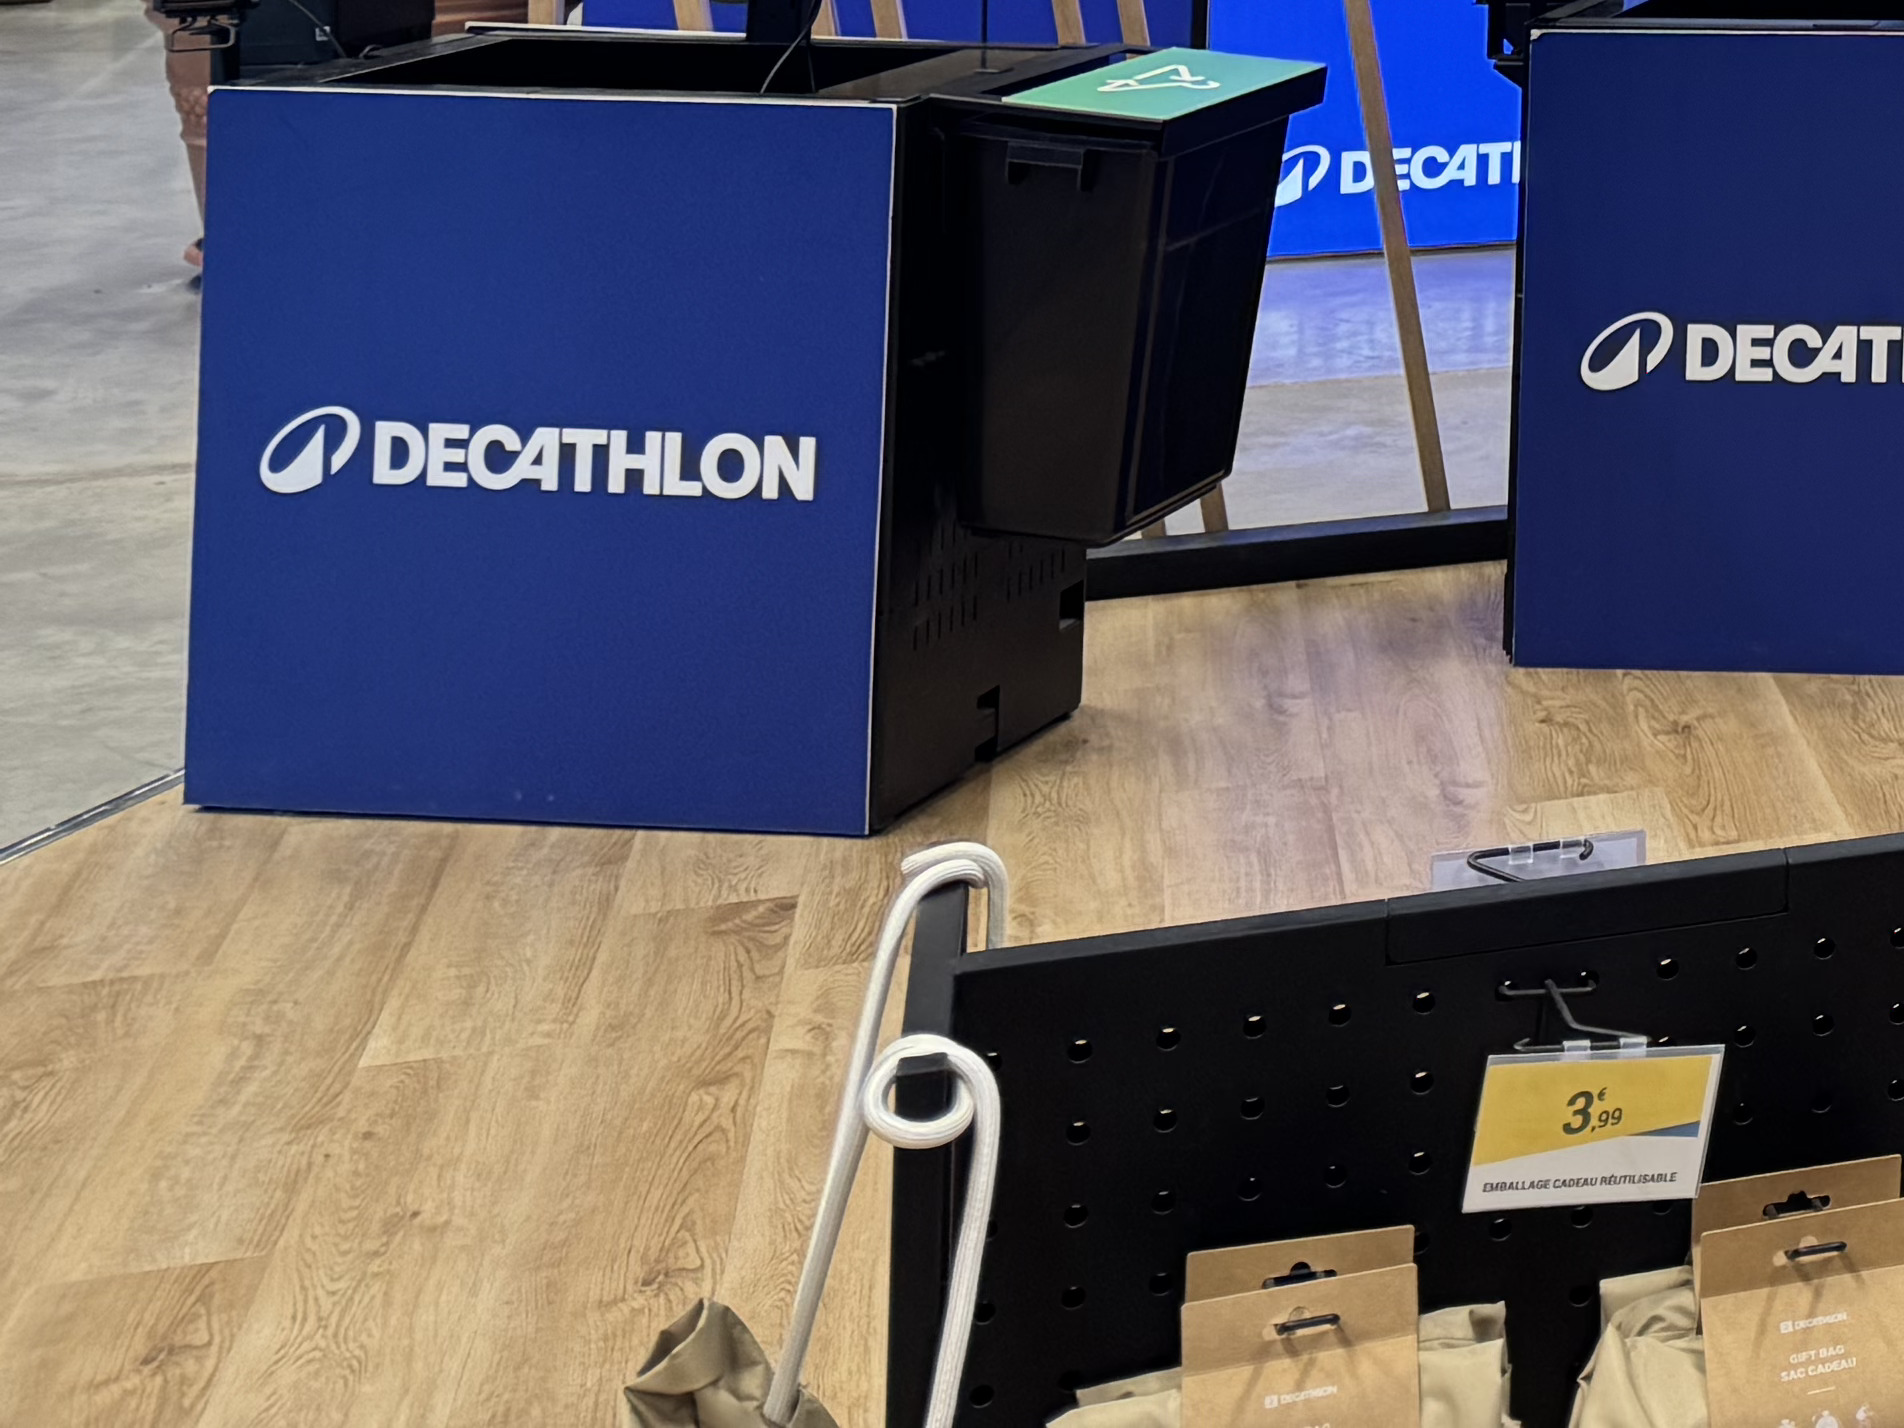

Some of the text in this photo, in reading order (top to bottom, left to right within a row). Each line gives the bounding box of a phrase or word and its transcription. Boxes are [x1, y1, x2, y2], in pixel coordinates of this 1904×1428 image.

[372, 420, 817, 501] DECATHLON
[1481, 1170, 1679, 1194] EMBALLAGE CADEAU RÉUTILISABLE
[1789, 1344, 1846, 1364] GIFT BAG
[1779, 1357, 1857, 1382] SAC CADEAU
